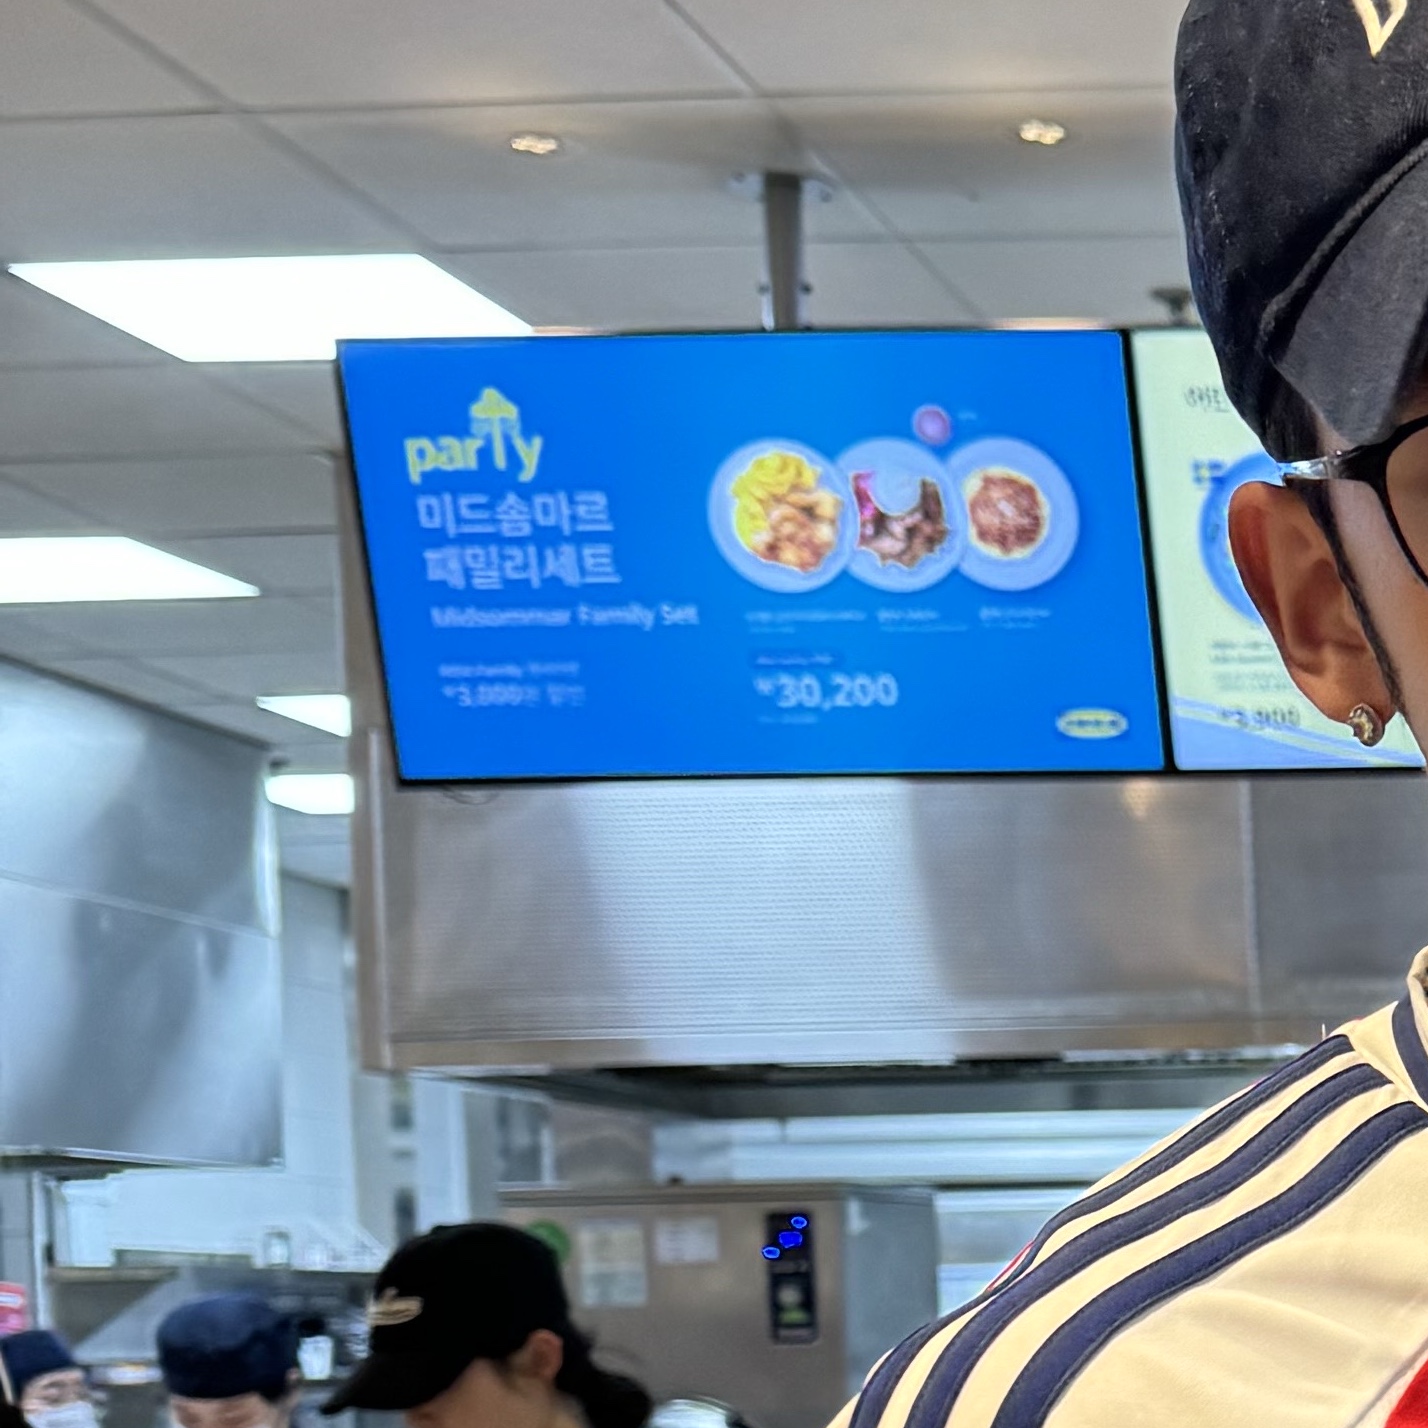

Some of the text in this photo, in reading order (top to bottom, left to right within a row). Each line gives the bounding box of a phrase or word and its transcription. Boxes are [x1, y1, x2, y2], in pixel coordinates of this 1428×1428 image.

[404, 387, 542, 484] party
[416, 490, 614, 539] 미드솜마르
[423, 543, 623, 590] 패밀리세트
[430, 601, 699, 631] Midsommar Family Set
[753, 671, 899, 711] ₩30,200
